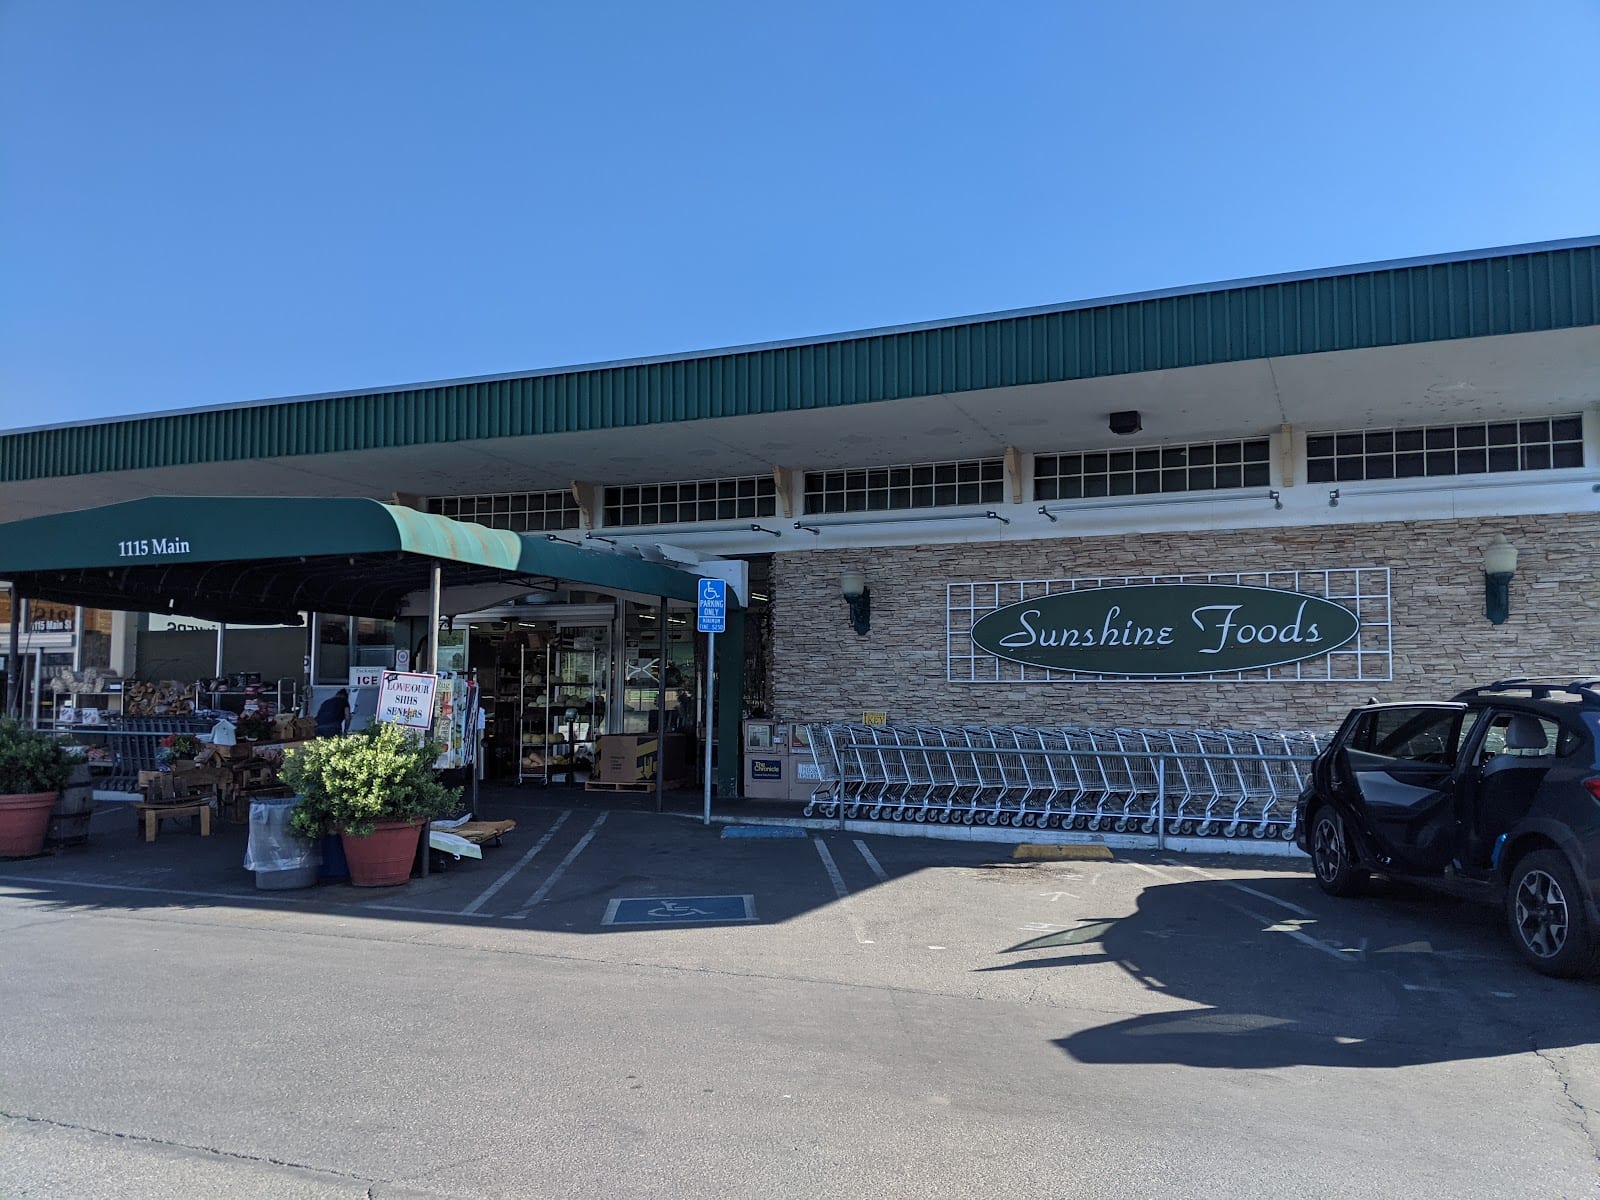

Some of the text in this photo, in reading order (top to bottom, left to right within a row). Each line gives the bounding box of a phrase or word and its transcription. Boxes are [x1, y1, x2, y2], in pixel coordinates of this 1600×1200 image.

[118, 537, 190, 557] 1115 Main
[699, 599, 724, 608] PARKING
[704, 608, 719, 616] ONLY
[46, 620, 63, 629] Main
[999, 600, 1323, 654] Sunshine Foods
[357, 676, 379, 685] ICE
[386, 682, 429, 695] LOVE OUR
